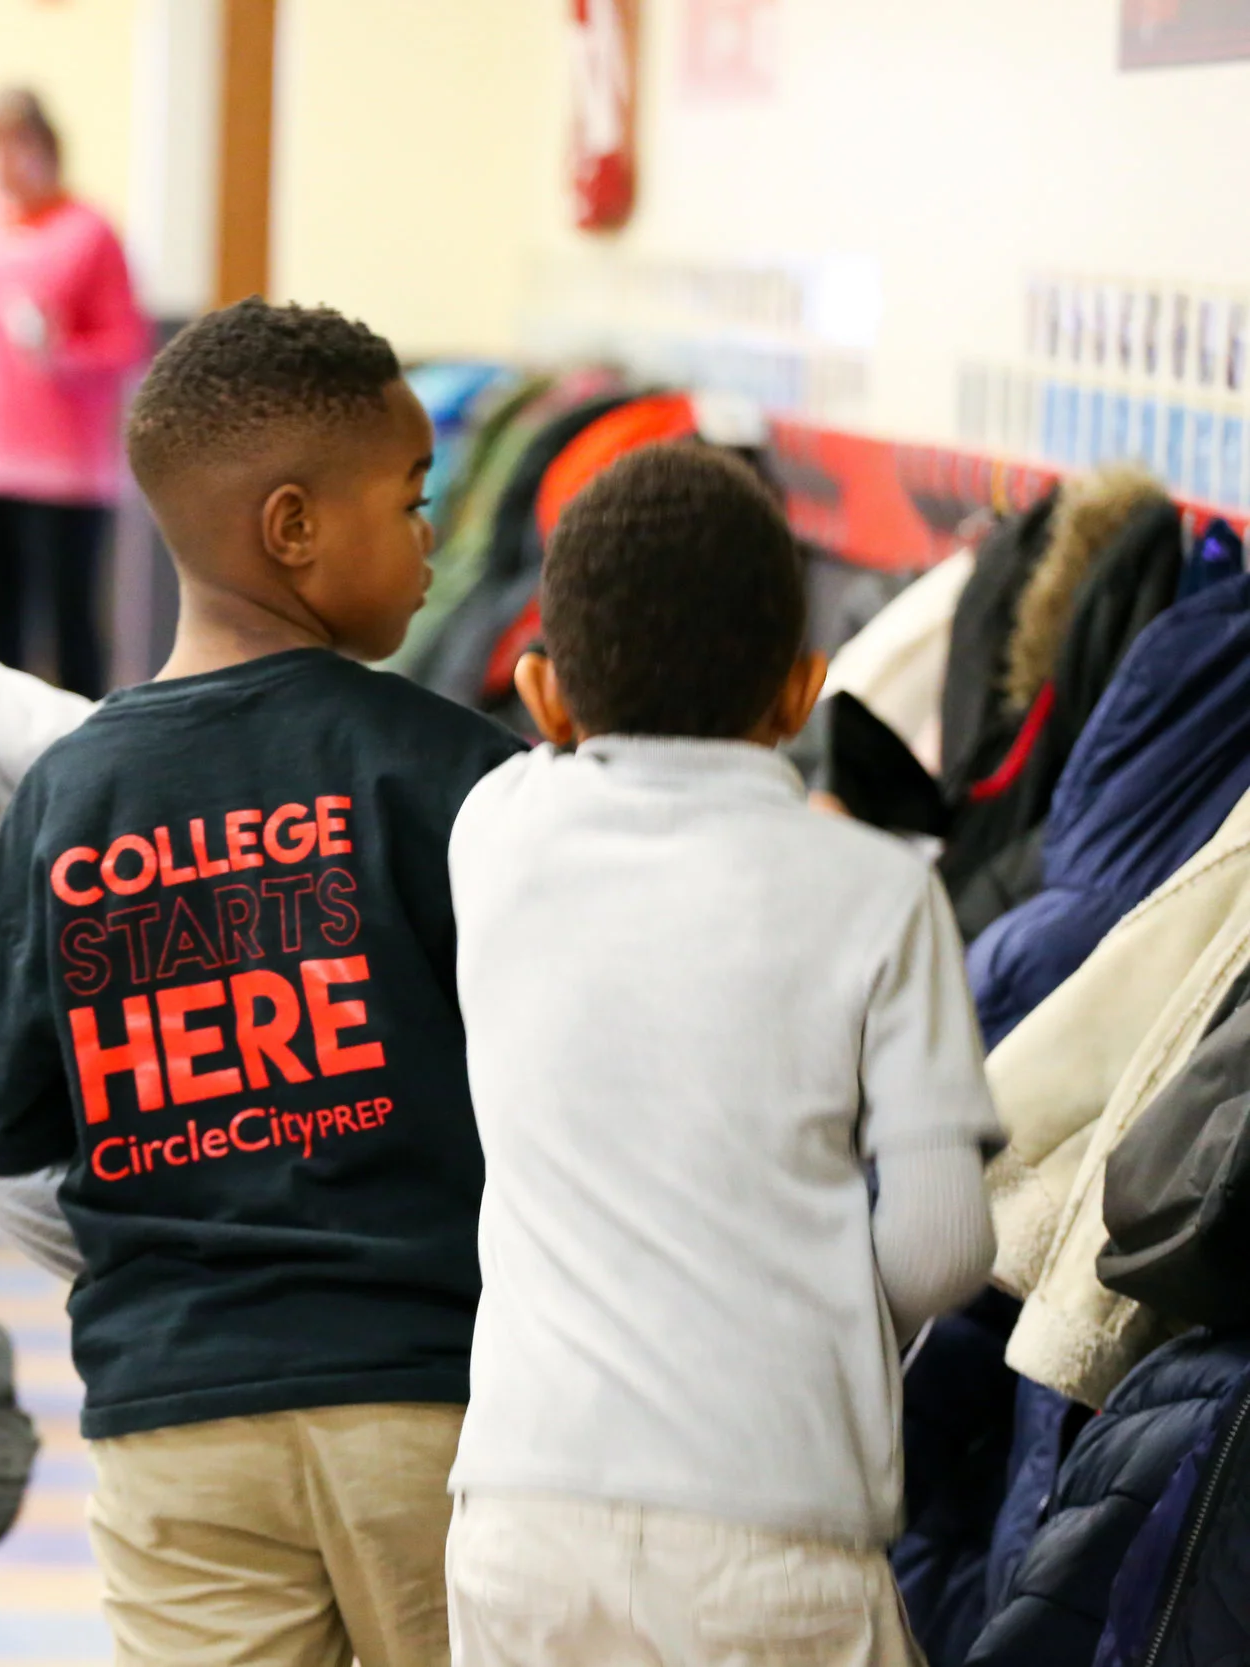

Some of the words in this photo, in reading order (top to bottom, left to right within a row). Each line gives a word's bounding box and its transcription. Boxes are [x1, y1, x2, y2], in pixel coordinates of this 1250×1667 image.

[51, 795, 352, 906] COLLEGE
[61, 868, 361, 996] STARTS
[68, 955, 386, 1125] HERE
